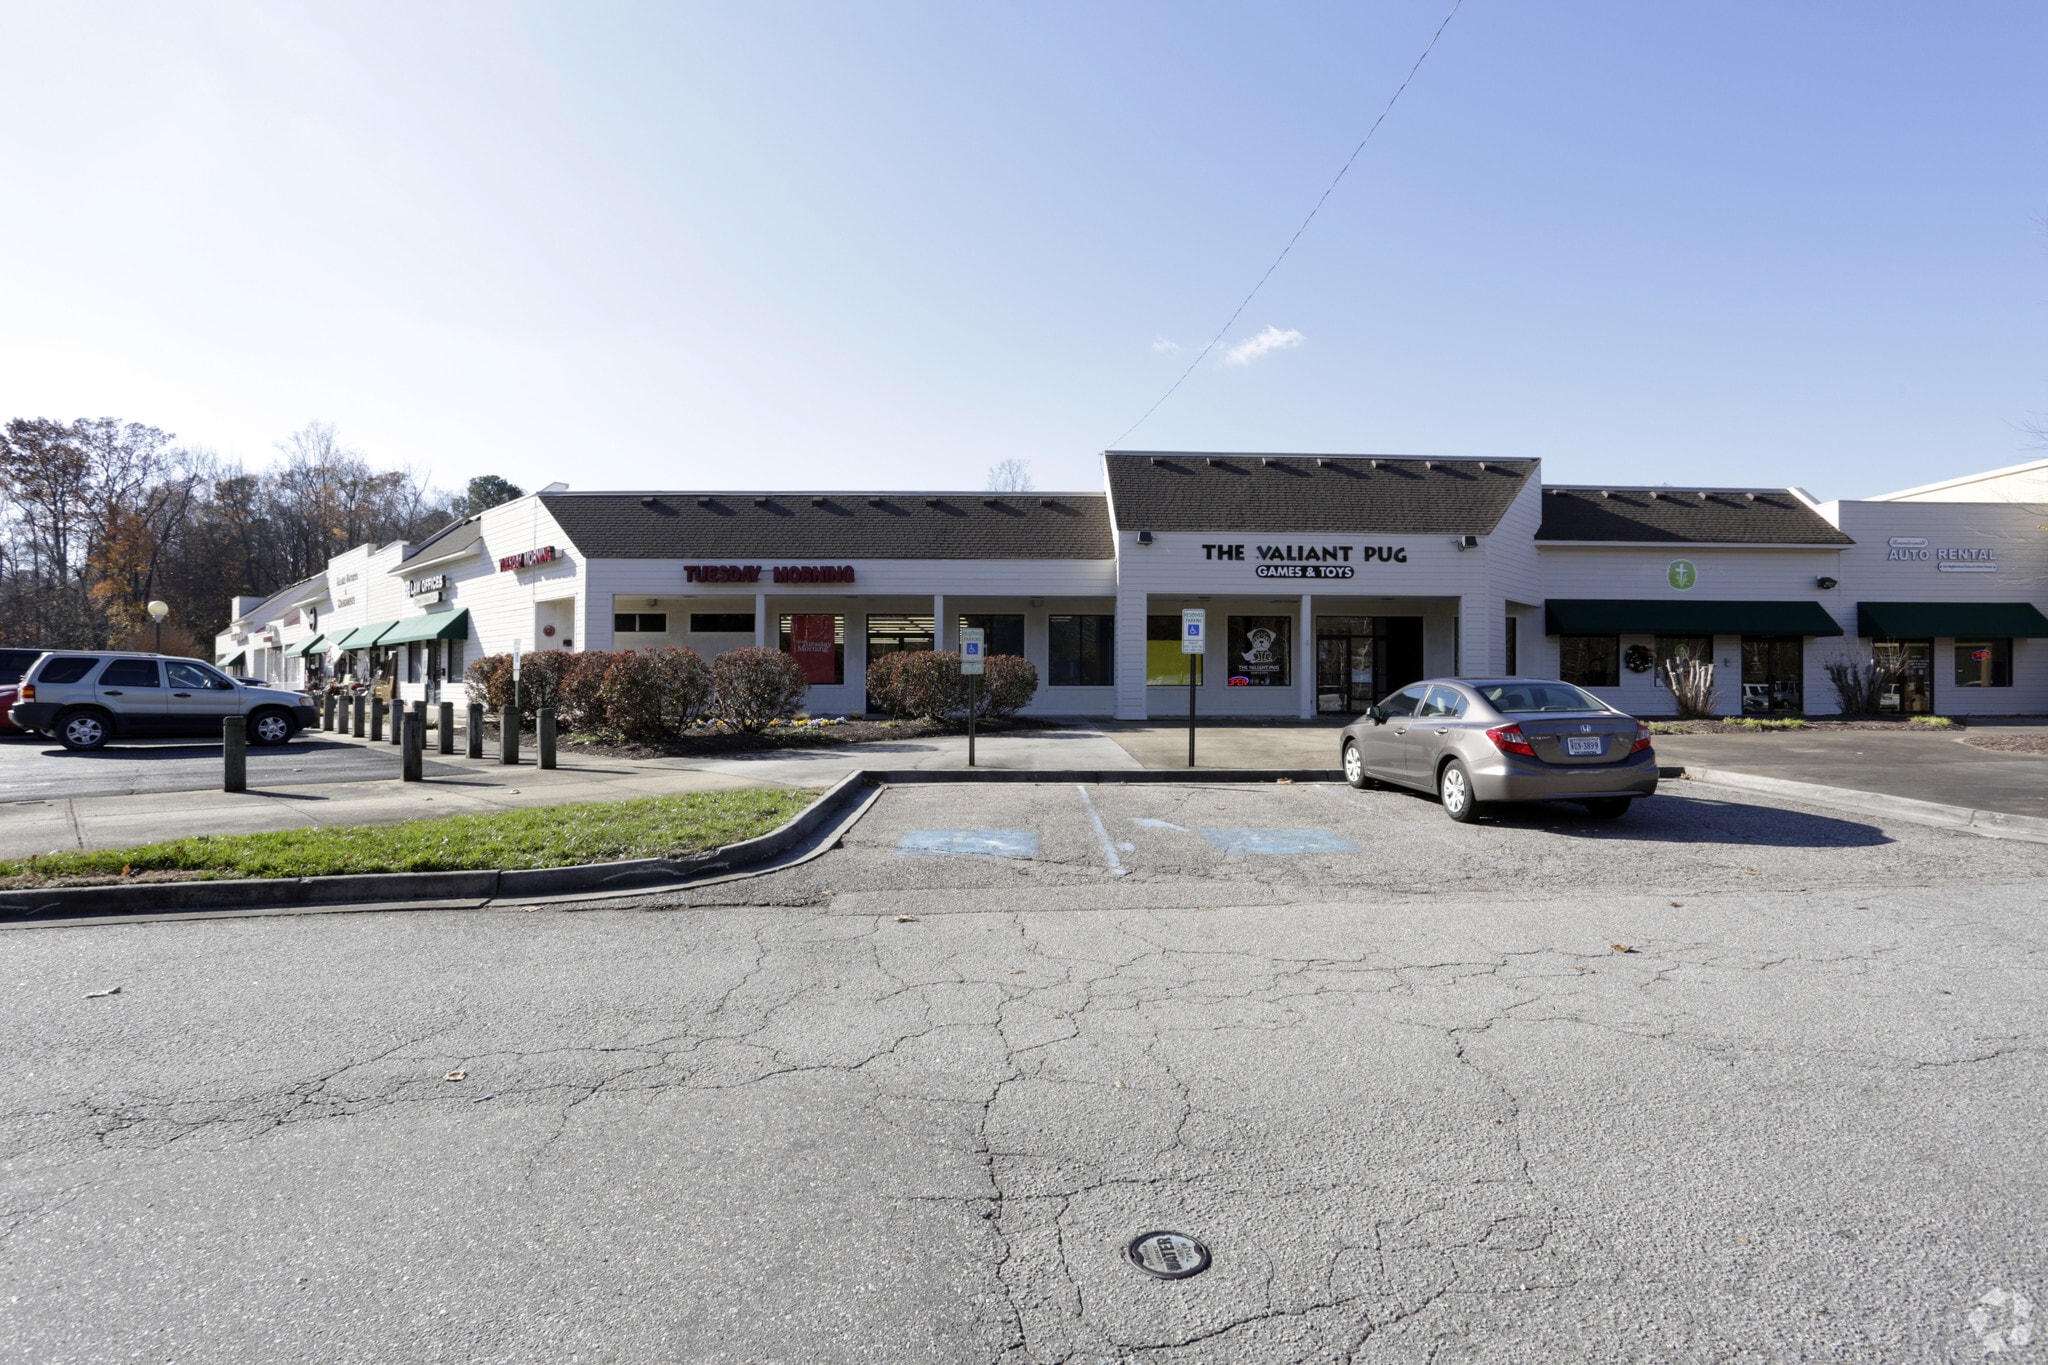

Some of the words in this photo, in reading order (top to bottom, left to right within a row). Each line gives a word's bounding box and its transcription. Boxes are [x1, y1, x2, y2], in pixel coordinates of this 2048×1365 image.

[1202, 544, 1245, 561] THE
[1256, 545, 1353, 562] VALIANT
[1364, 546, 1407, 563] PUG
[1888, 549, 1930, 561] AUTO
[1937, 549, 1997, 560] RENTAL
[684, 565, 762, 583] TUESDAY
[773, 565, 855, 583] MORNING
[1257, 566, 1302, 578] GAMES
[1305, 566, 1316, 578] &
[1320, 566, 1352, 578] TOYS
[410, 580, 421, 597] LAW
[421, 575, 445, 592] OFFICES
[798, 645, 829, 653] Morning
[801, 640, 832, 648] Tuesday
[1227, 678, 1248, 687] OPEN
[1157, 1238, 1182, 1270] WATER
